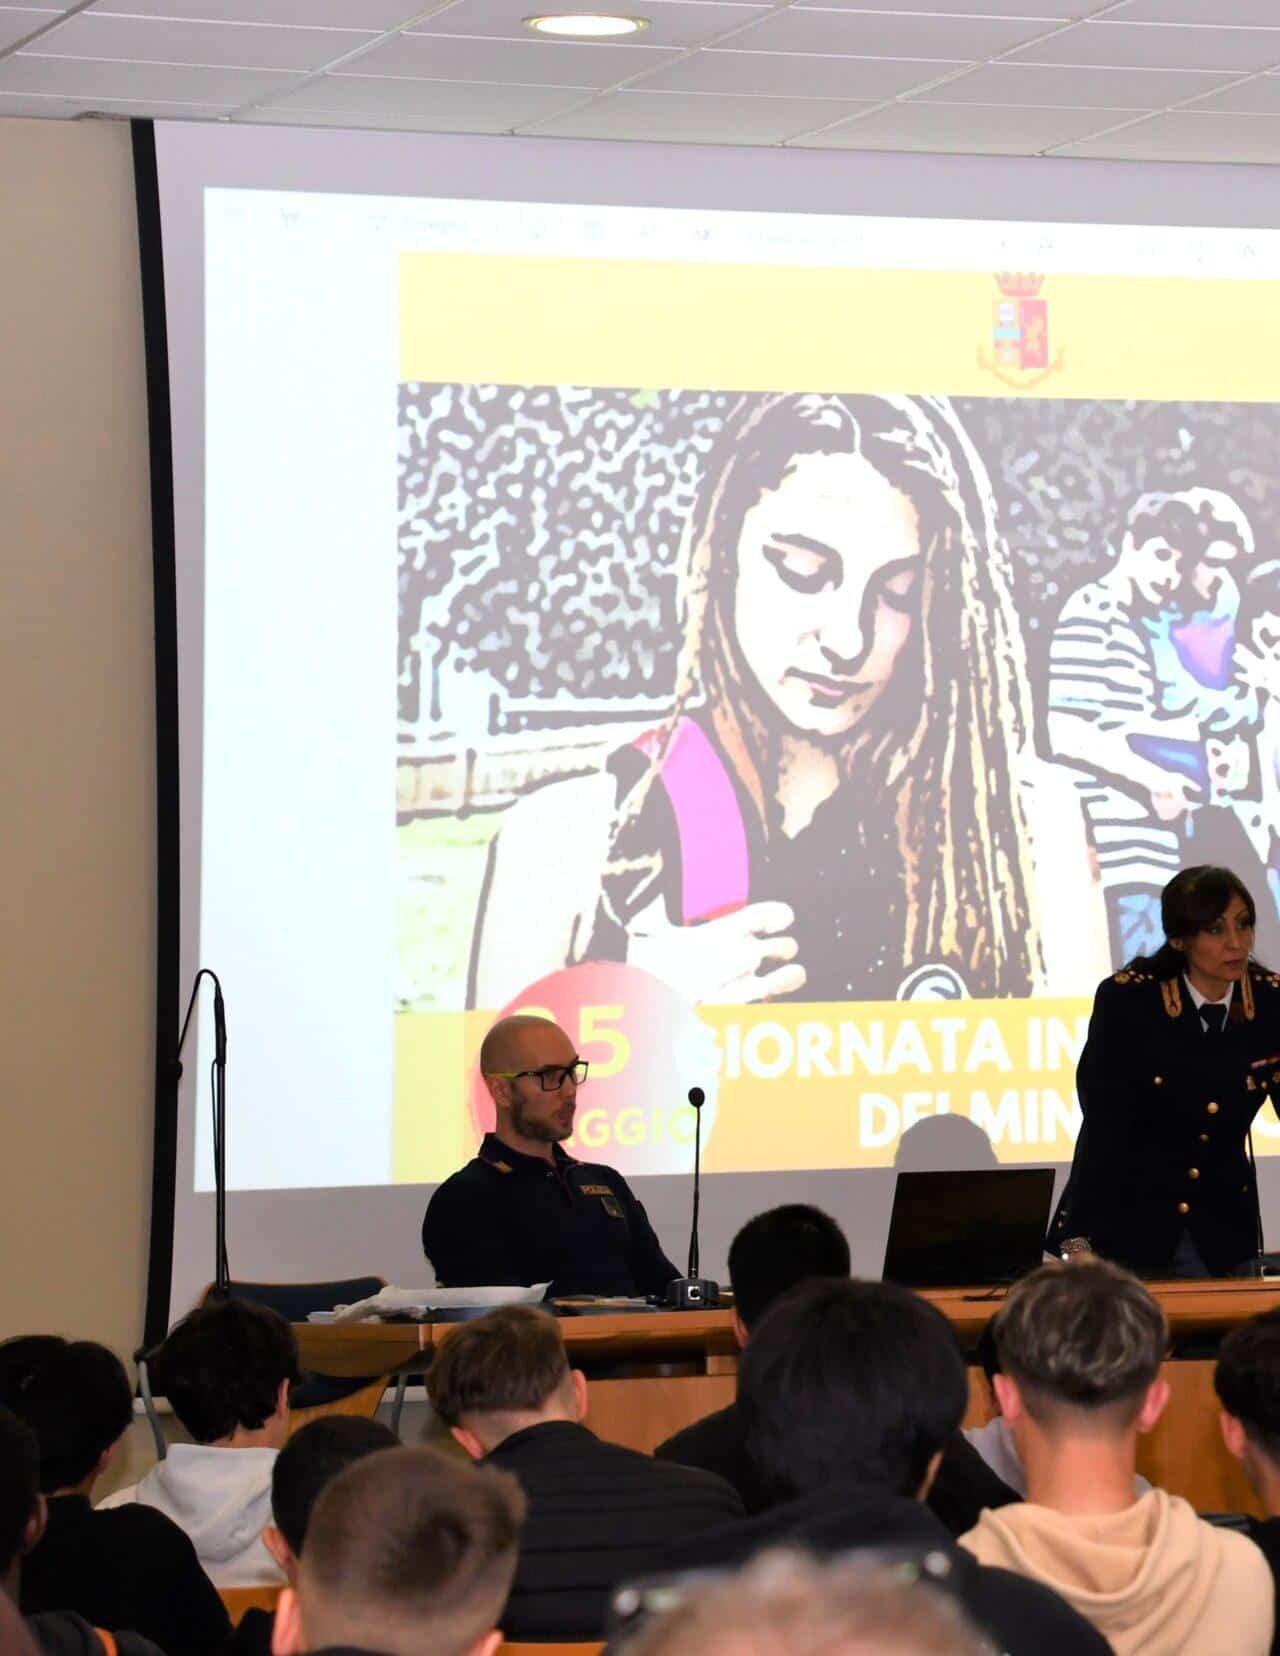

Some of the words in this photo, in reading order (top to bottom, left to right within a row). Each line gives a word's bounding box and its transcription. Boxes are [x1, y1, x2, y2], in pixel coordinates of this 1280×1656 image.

[512, 1004, 631, 1078] 5
[674, 1017, 1014, 1079] GIORNATA
[564, 1107, 704, 1147] GGIO
